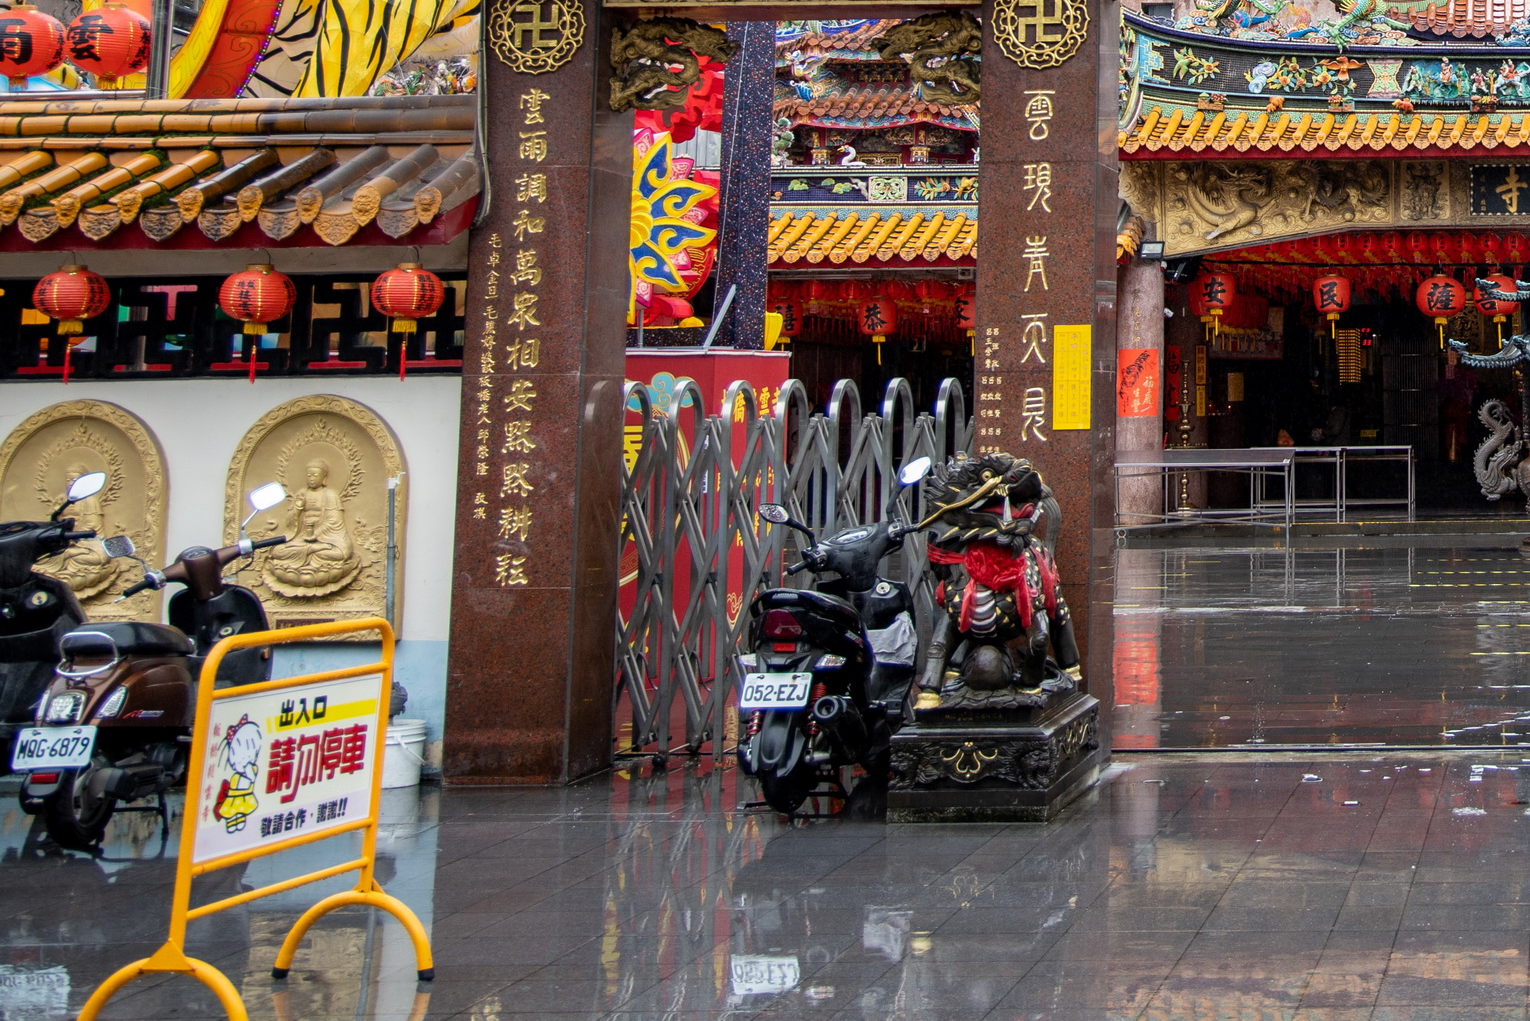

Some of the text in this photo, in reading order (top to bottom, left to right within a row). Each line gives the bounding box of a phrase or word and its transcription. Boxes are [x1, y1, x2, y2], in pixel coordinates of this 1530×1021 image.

[66, 13, 115, 63] 雲
[1202, 277, 1227, 304] 安
[1319, 281, 1344, 308] 民
[1427, 282, 1457, 311] 薩
[863, 303, 888, 332] 恭
[279, 695, 328, 728] 出入口
[265, 723, 369, 805] 請勿停車
